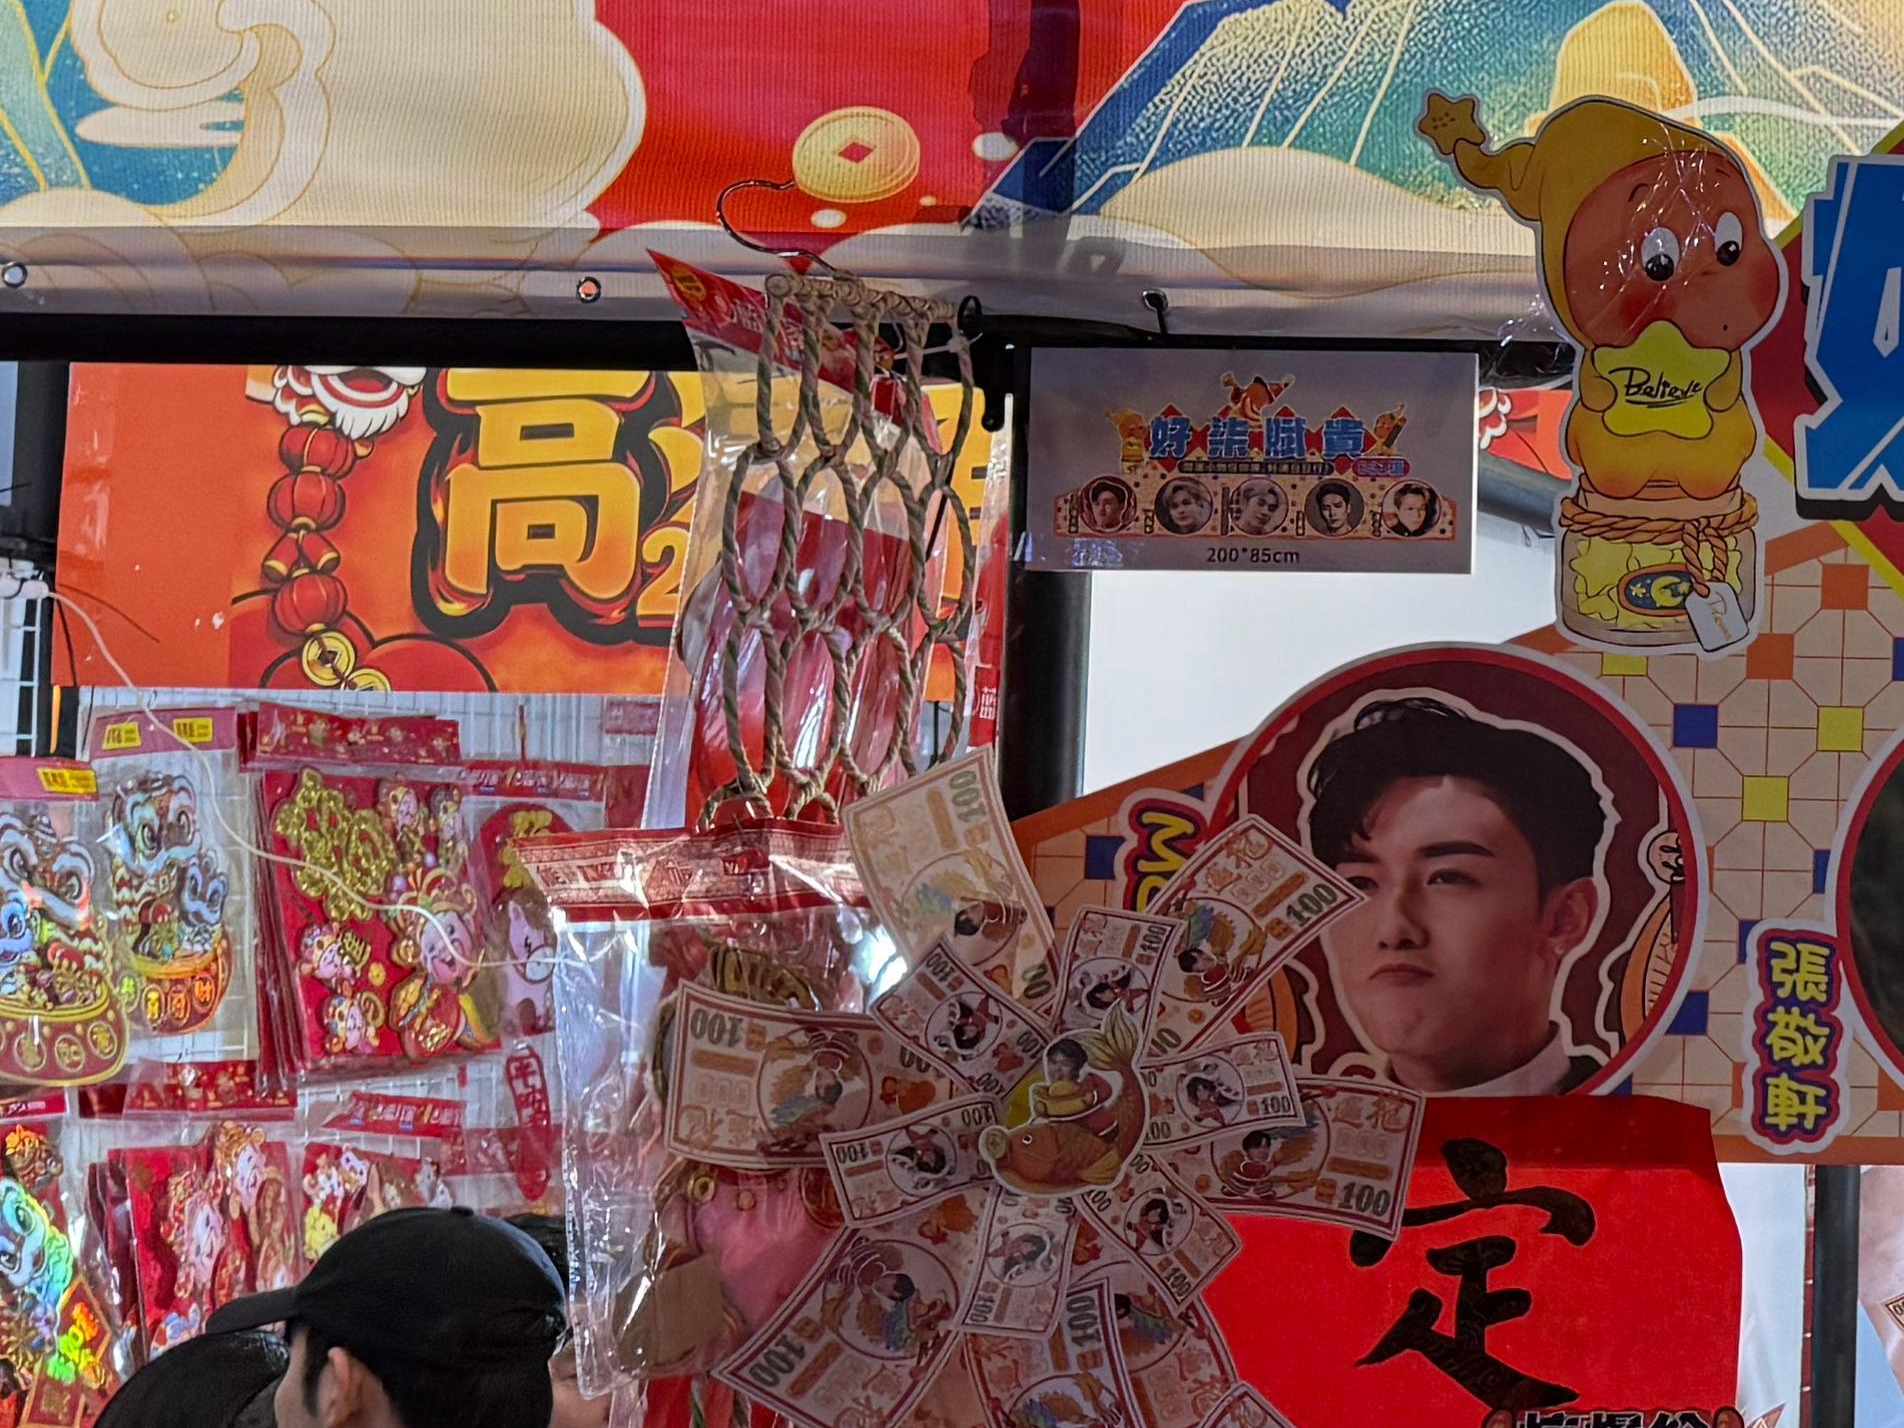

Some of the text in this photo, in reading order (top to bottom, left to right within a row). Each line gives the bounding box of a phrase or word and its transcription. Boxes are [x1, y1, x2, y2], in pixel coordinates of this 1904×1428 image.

[1608, 366, 1703, 400] Believe
[1764, 941, 1838, 1133] 張敬軒
